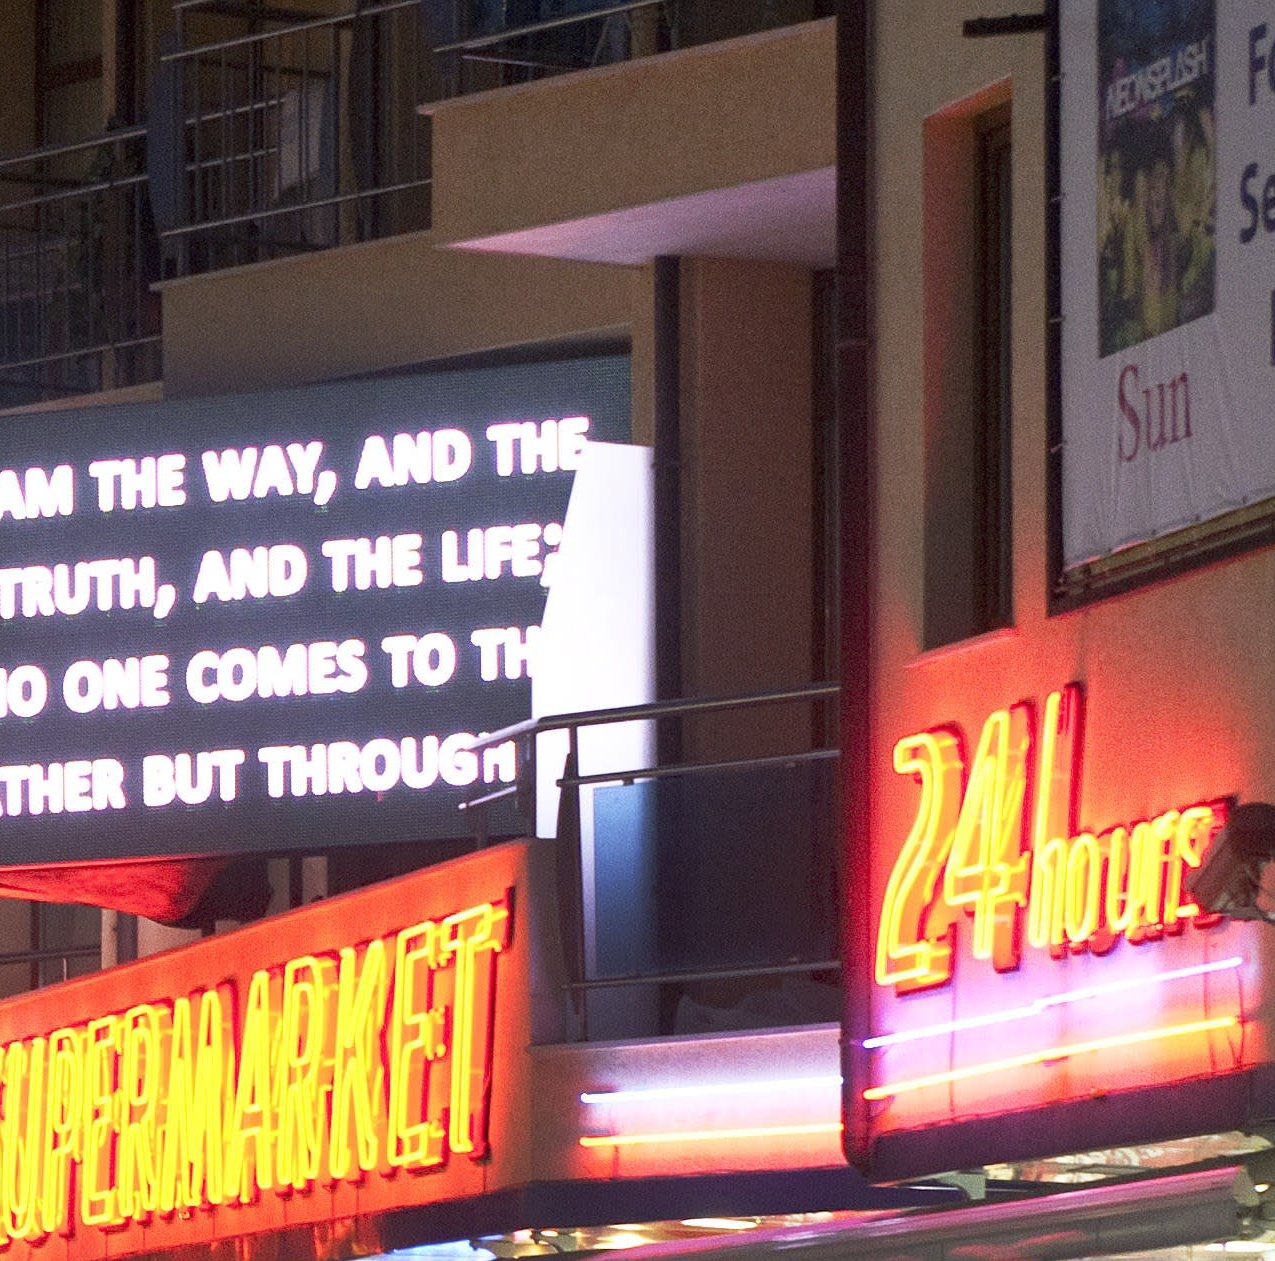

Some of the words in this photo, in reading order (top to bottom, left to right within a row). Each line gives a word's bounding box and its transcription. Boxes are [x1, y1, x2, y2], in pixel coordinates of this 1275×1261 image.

[1118, 364, 1193, 463] Sun
[88, 453, 188, 512] THE
[201, 440, 337, 507] WAY,
[354, 428, 472, 490] AND
[487, 415, 590, 477] THE
[192, 543, 308, 604] AND
[322, 532, 423, 594] THE
[62, 655, 170, 713] ONE
[184, 639, 366, 704] COMES
[382, 633, 455, 687] TO
[142, 748, 245, 809] BUT
[875, 710, 1026, 988] 24
